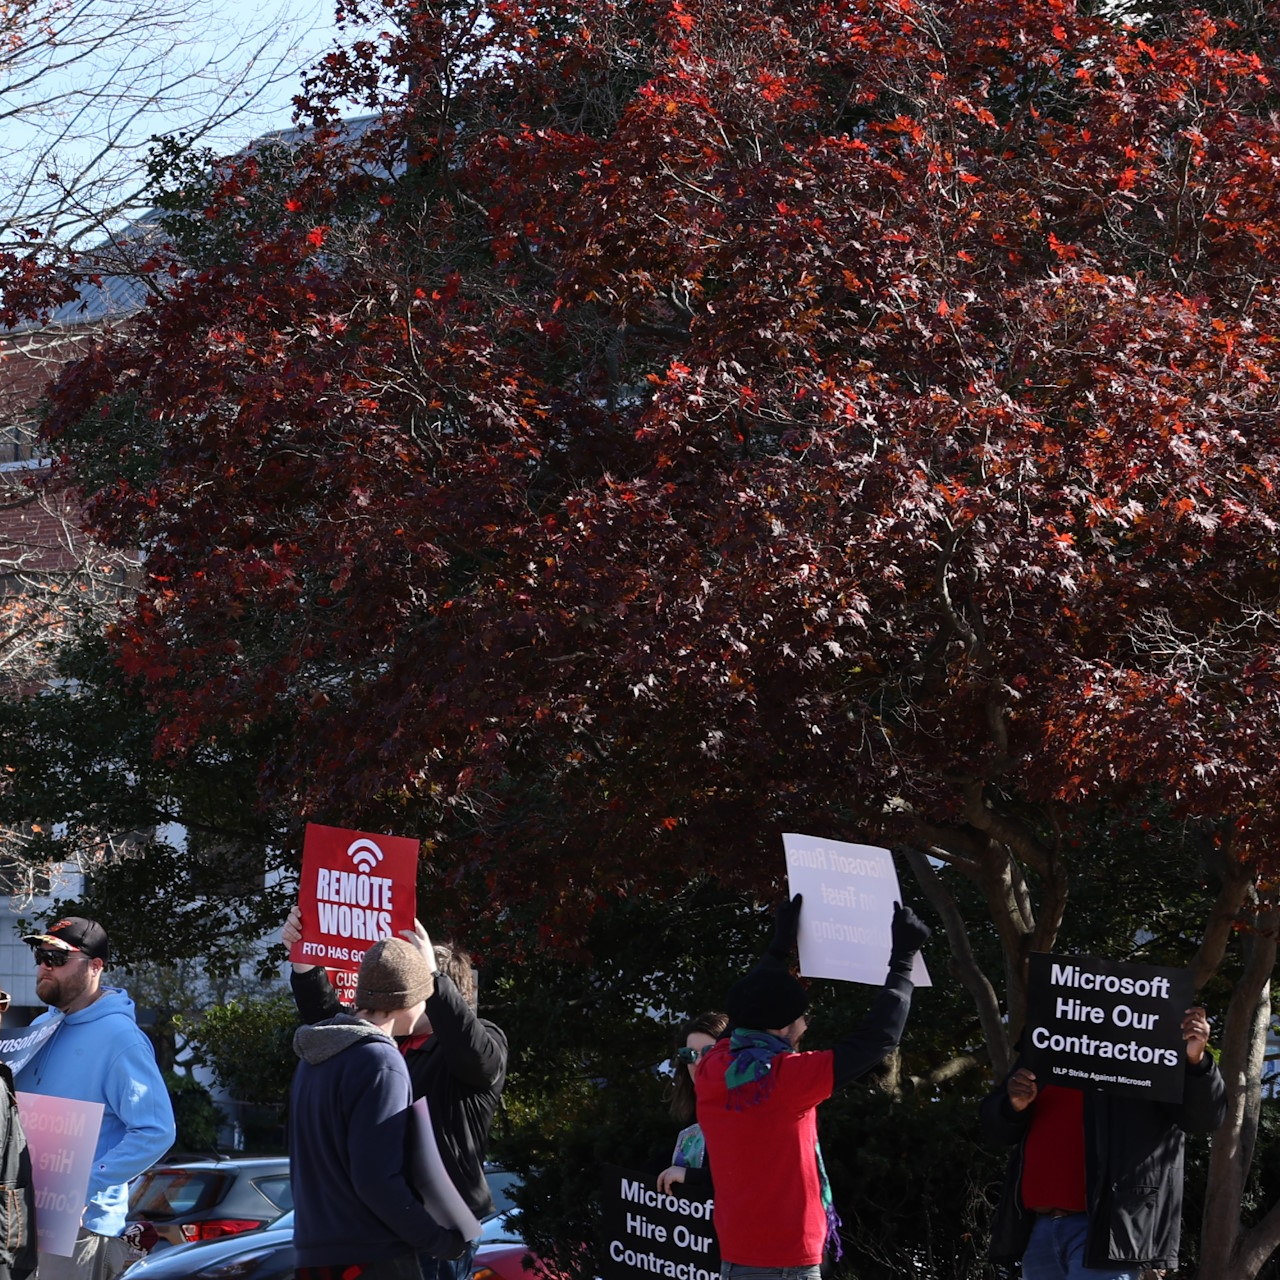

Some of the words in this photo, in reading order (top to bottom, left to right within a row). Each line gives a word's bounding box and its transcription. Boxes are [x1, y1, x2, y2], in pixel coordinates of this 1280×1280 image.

[316, 868, 393, 911] REMOTE
[317, 902, 393, 942] WORKS
[302, 942, 326, 957] RTO
[327, 946, 349, 961] HAS
[351, 950, 365, 963] GO
[1050, 963, 1171, 999] Microsoft
[1055, 997, 1106, 1024] Hire
[1111, 1004, 1160, 1031] Our
[1031, 1026, 1179, 1067] Contractors
[1052, 1066, 1067, 1075] ULP
[1068, 1068, 1089, 1079] Strike
[1089, 1072, 1117, 1083] Against
[1117, 1075, 1152, 1087] Microsoft
[620, 1178, 715, 1221] Microsof
[626, 1212, 668, 1243] Hire
[673, 1225, 713, 1254] Our
